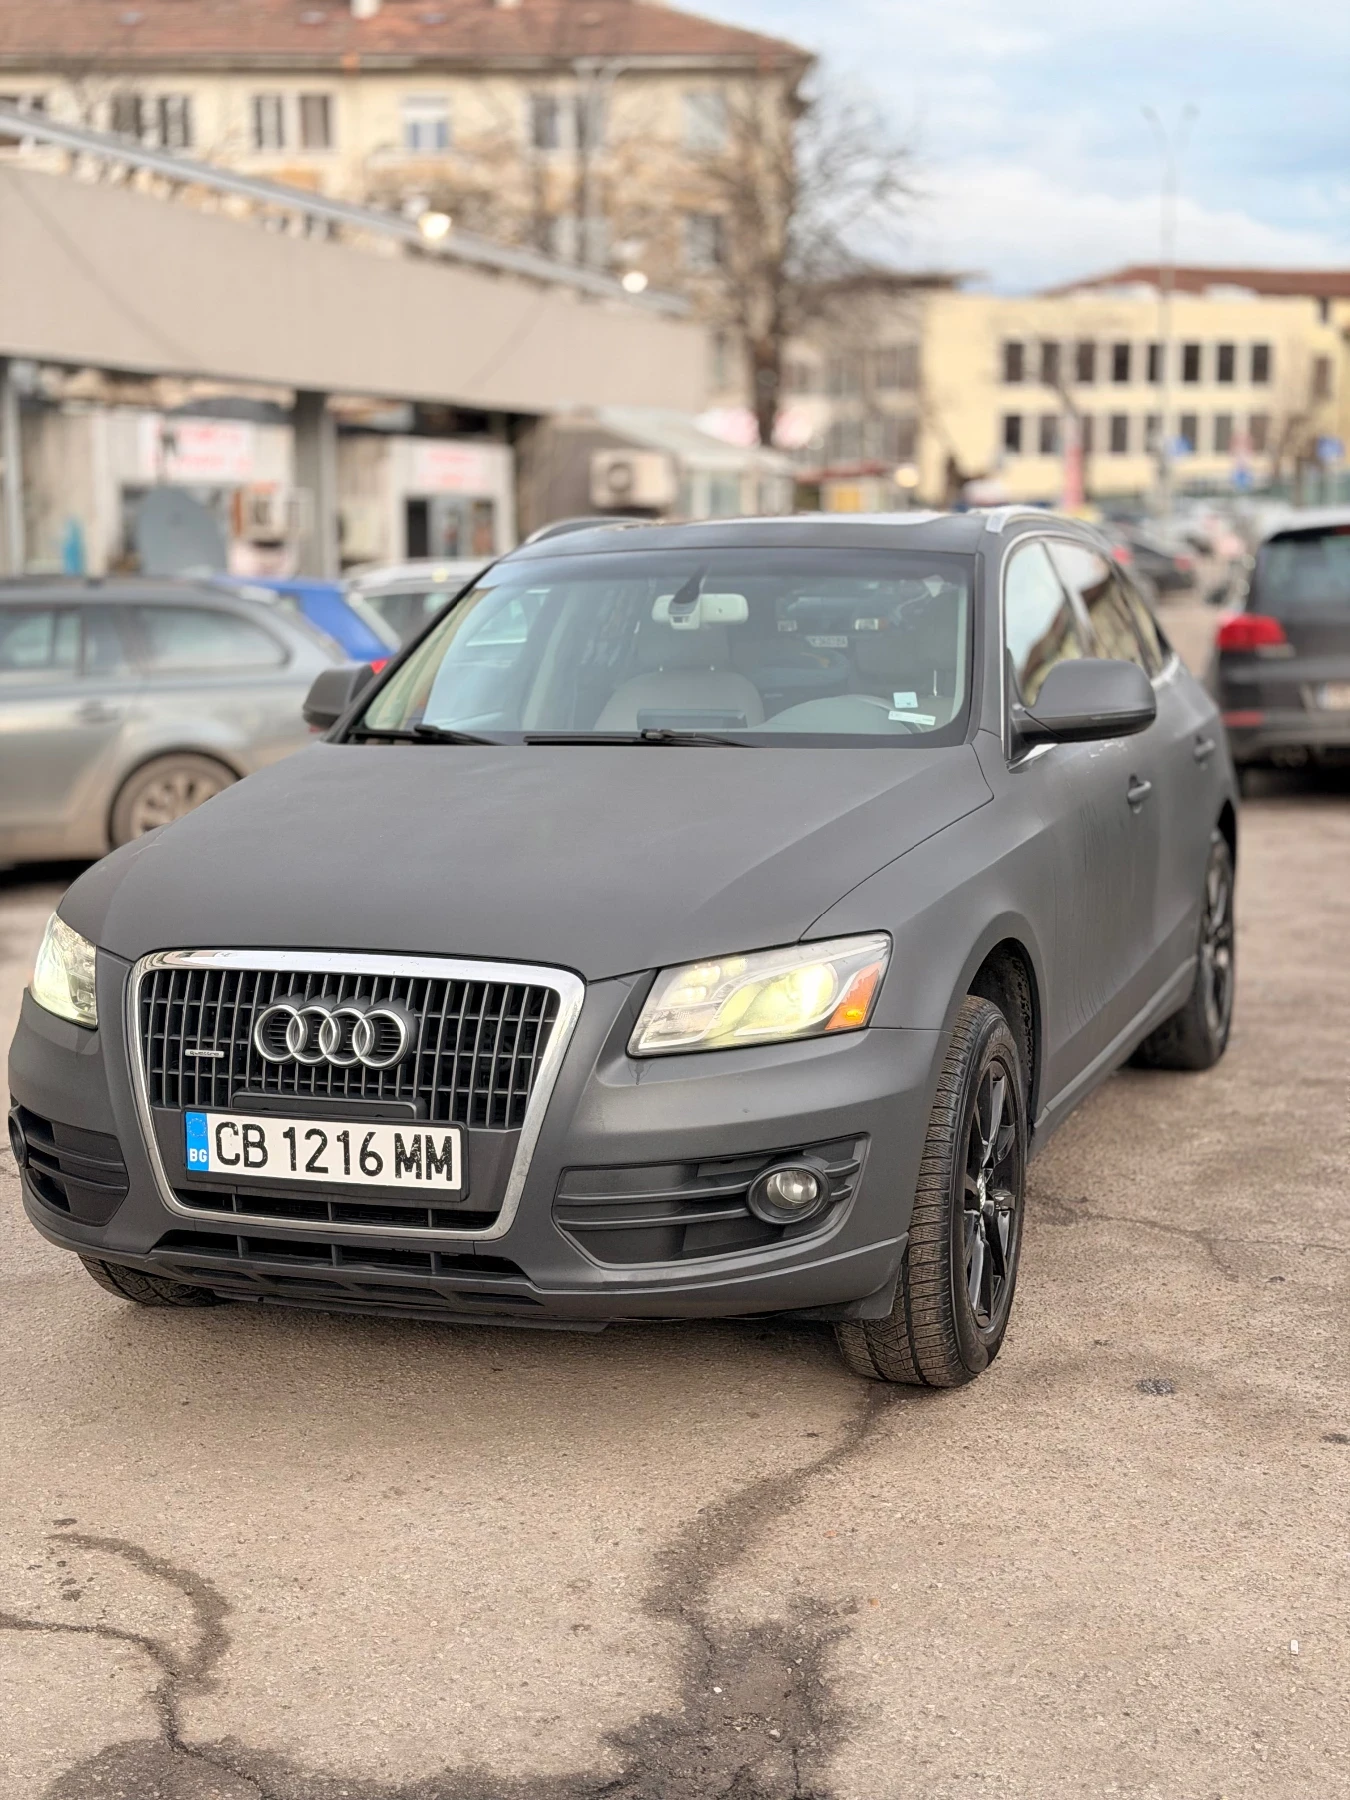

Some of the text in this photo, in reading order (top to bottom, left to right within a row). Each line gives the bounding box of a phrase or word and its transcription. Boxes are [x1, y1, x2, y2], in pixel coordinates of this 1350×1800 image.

[189, 1148, 208, 1163] BG
[215, 1121, 453, 1182] CB 1216 MM
